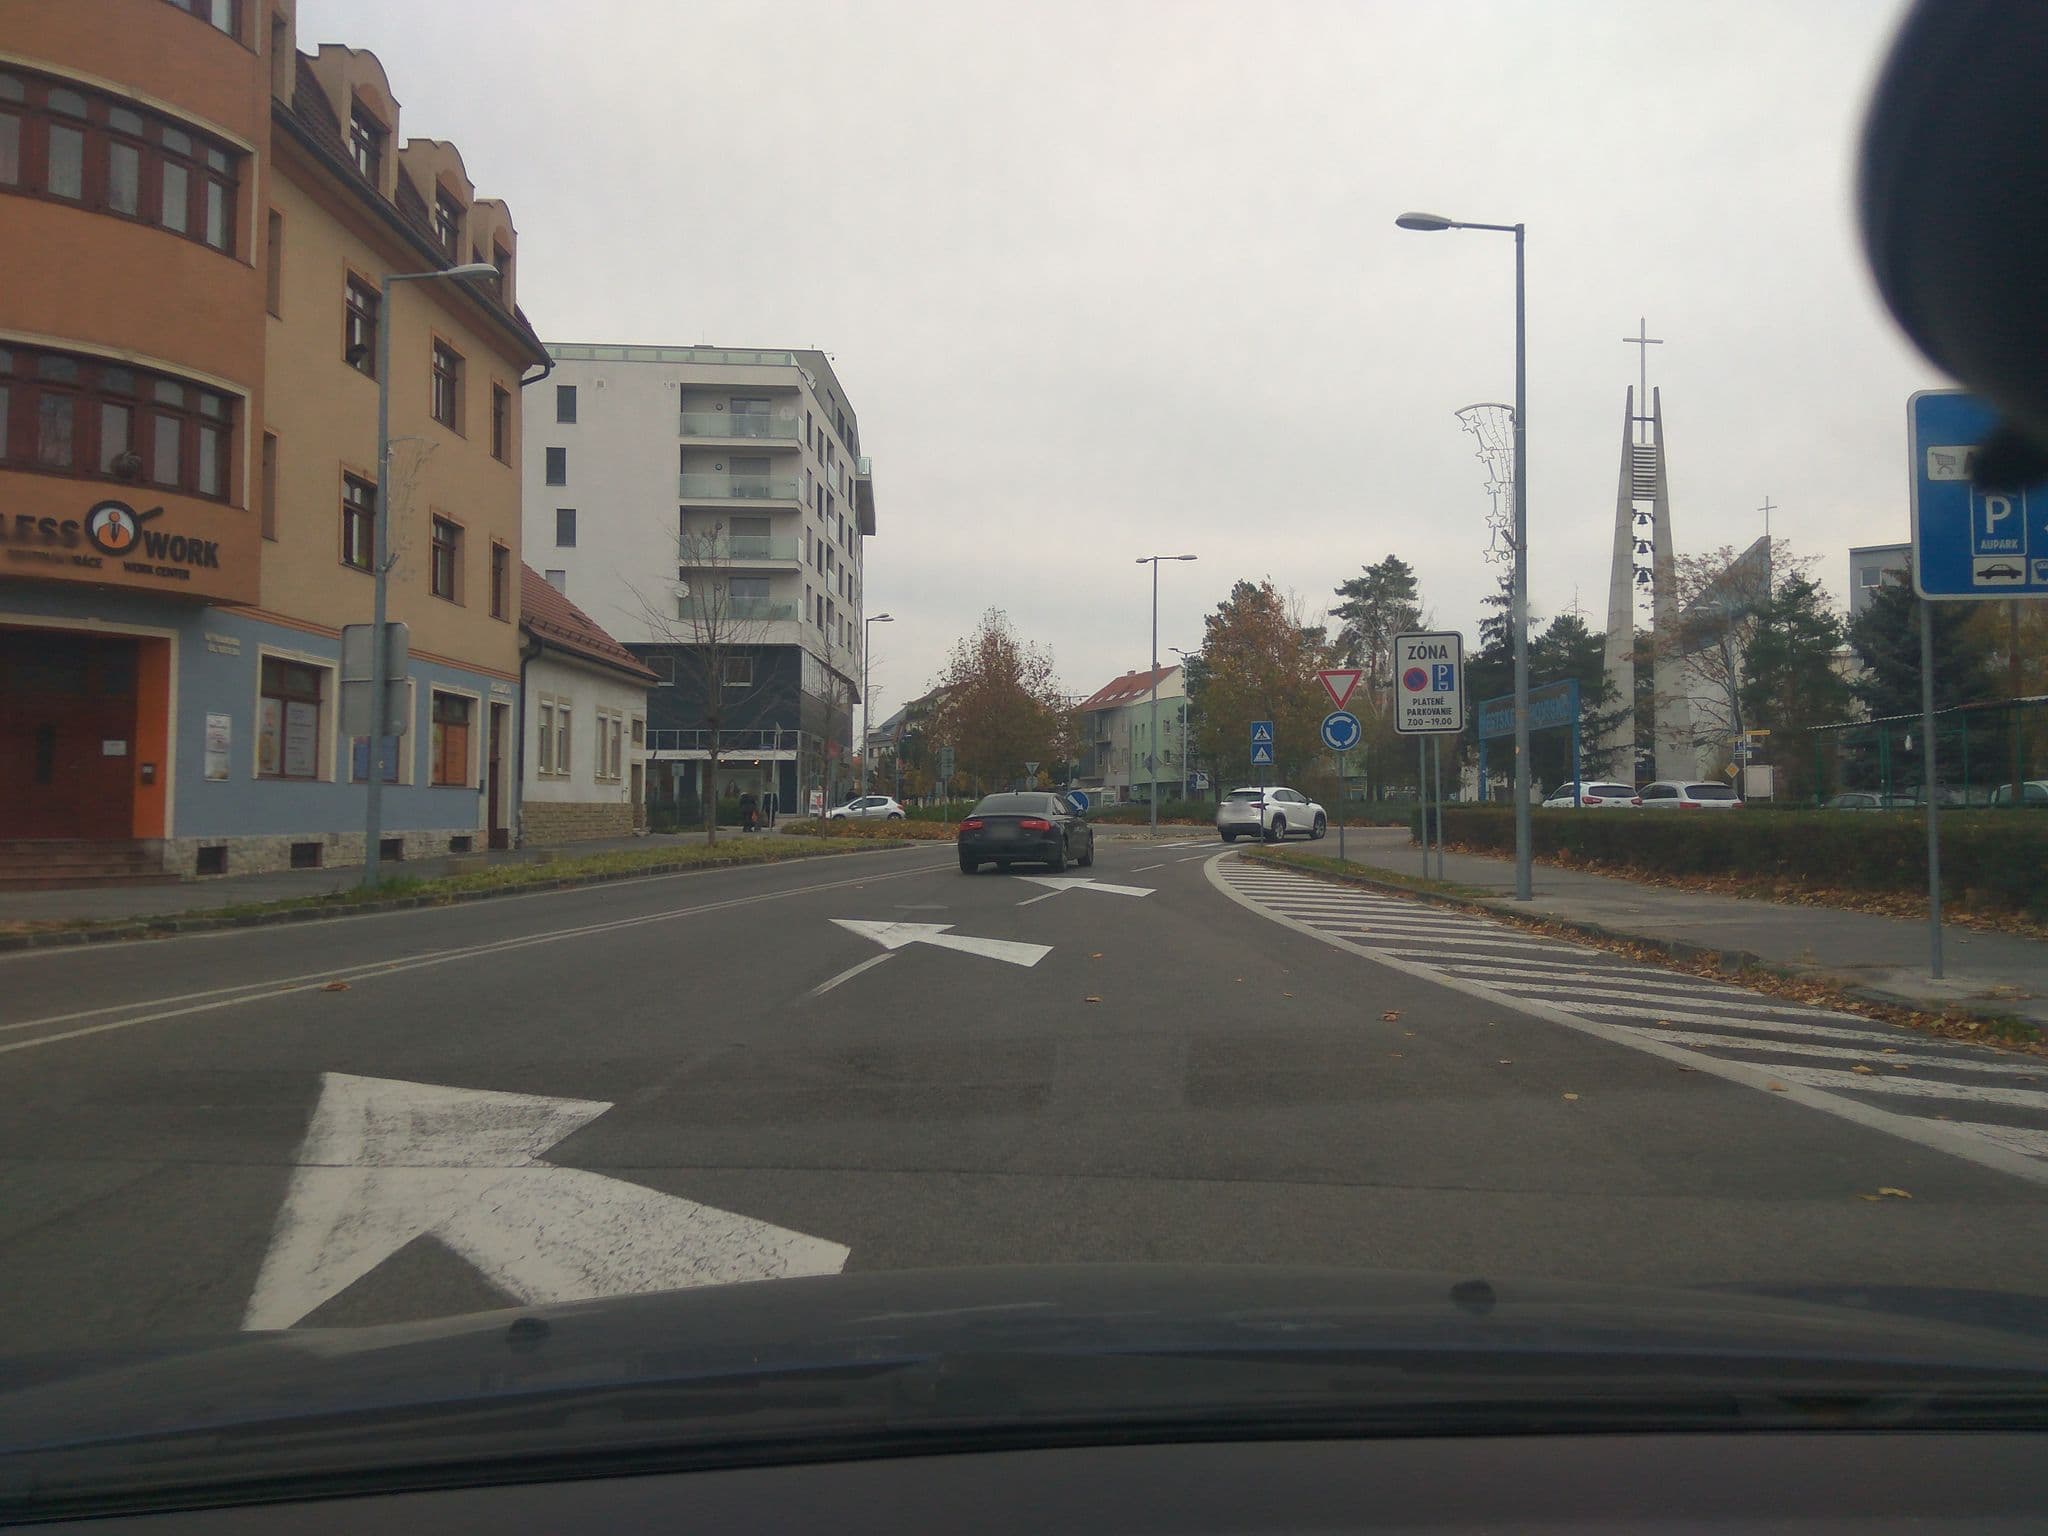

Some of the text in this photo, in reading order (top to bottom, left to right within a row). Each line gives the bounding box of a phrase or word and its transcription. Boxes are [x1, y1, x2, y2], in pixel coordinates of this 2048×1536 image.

[143, 529, 219, 569] WORK
[1981, 539, 2018, 550] AUPARK
[155, 565, 190, 581] CENTER
[1408, 641, 1448, 660] ZÓNA
[1412, 696, 1446, 706] PLATENÉ
[1407, 707, 1453, 716] PARKOVANIE
